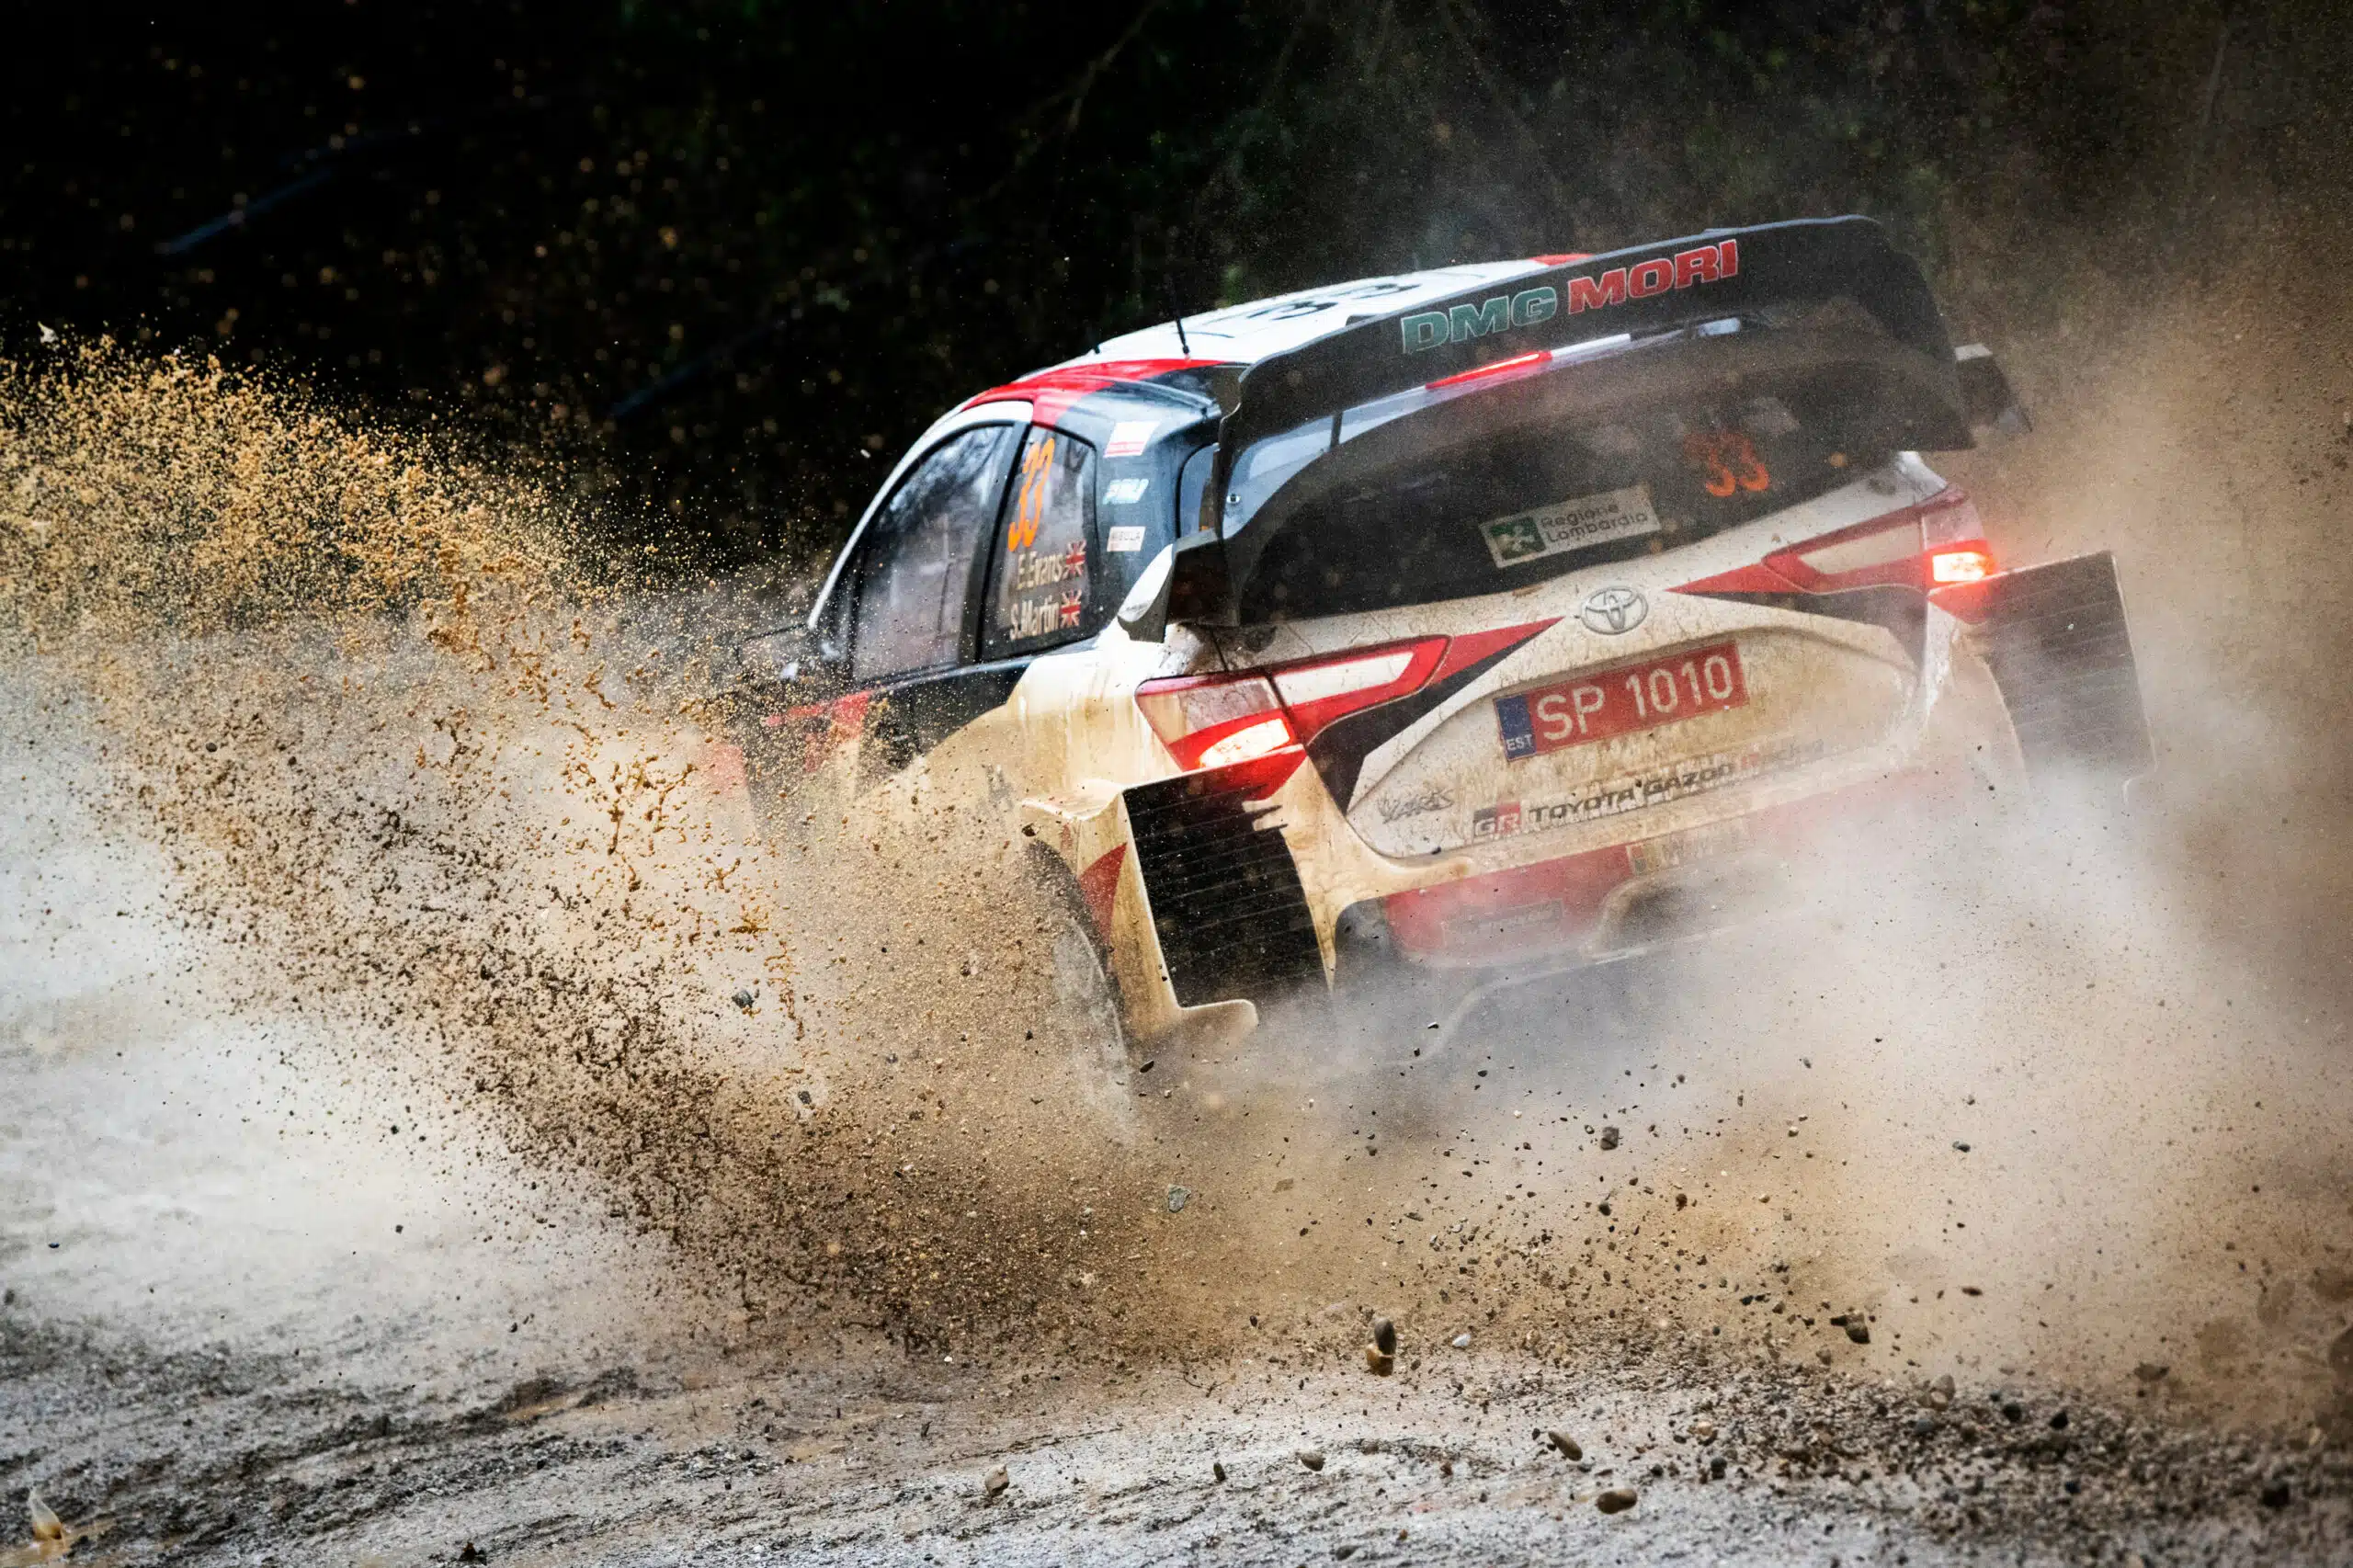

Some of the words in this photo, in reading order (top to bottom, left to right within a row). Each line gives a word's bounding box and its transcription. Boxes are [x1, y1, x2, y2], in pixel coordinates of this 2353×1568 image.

[1400, 286, 1558, 354] DMG
[1567, 239, 1739, 314] MORI
[1684, 432, 1770, 497] 33
[1007, 437, 1055, 551] 33
[1540, 504, 1619, 528] Regione
[1546, 513, 1648, 542] Lombardia
[1536, 685, 1606, 740] SP
[1625, 654, 1733, 719] 1010
[1506, 733, 1534, 752] EST
[1529, 788, 1635, 824] TOYOTA
